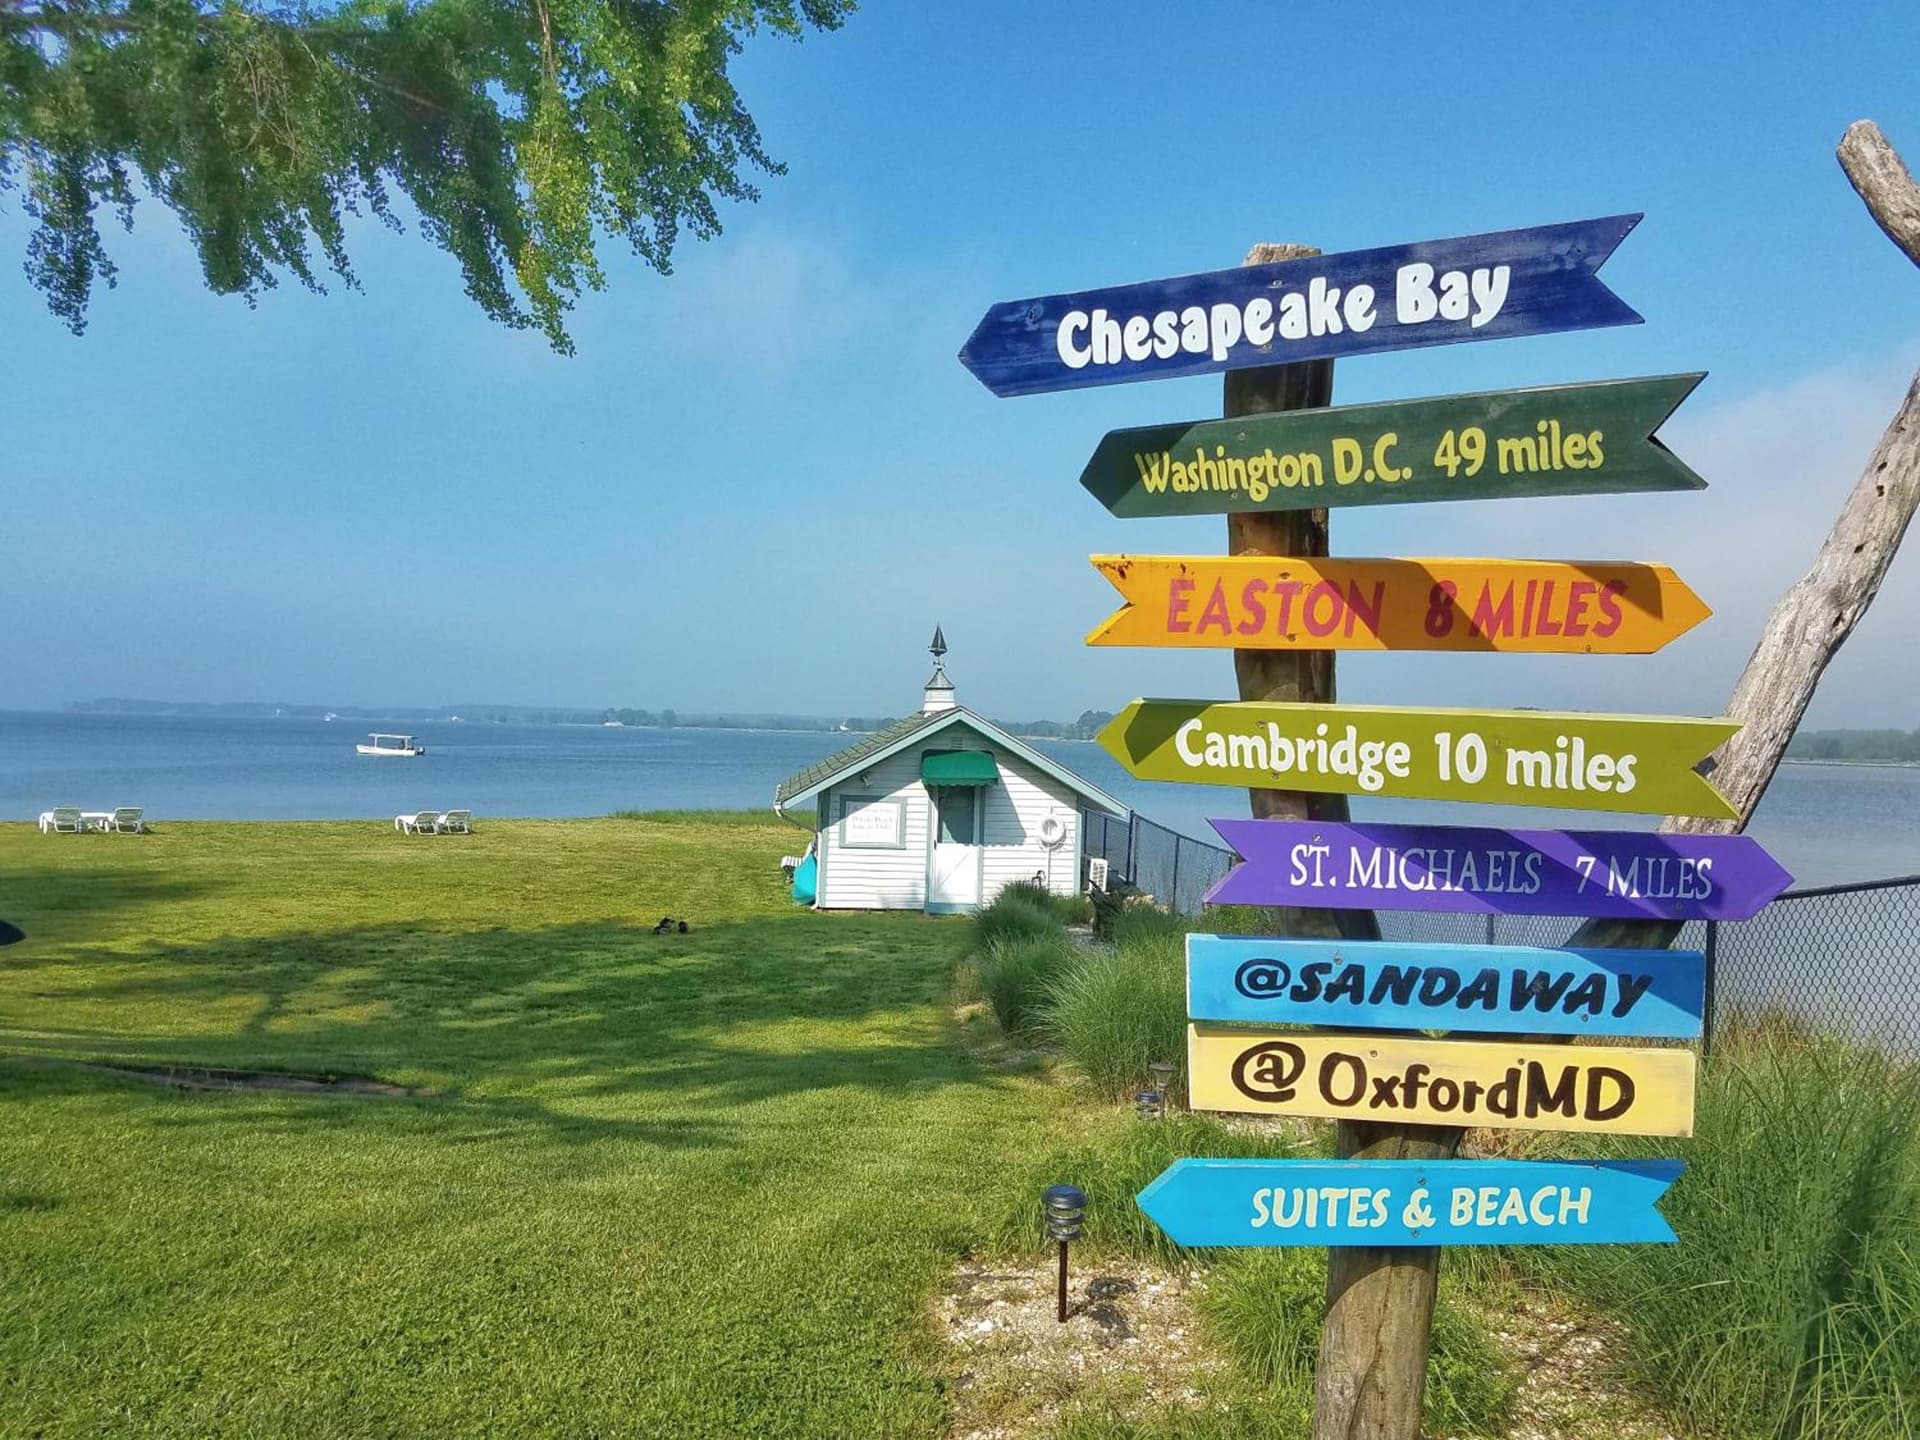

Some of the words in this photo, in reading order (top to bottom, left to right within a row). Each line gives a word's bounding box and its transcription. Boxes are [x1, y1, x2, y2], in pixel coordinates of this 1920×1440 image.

[1056, 276, 1378, 369] Chesapeake
[1395, 262, 1511, 328] Bay
[1134, 445, 1324, 503] Washington
[1331, 432, 1413, 485] D.C.
[1434, 428, 1487, 476] 49
[1495, 419, 1605, 476] miles
[1166, 578, 1385, 640] EASTON
[1424, 581, 1455, 638] 8
[1470, 579, 1626, 639] MILES
[1175, 718, 1411, 793] Cambridge
[1434, 732, 1488, 784] 10
[1505, 734, 1638, 795] miles
[1289, 844, 1338, 888] ST.
[1346, 847, 1543, 896] MICHAELS
[1575, 855, 1596, 894] 7
[1607, 856, 1714, 900] MILES
[1234, 958, 1654, 1018] @SANDAWAY
[1250, 1187, 1389, 1230] SUITES
[1402, 1187, 1436, 1230] &
[1449, 1186, 1592, 1228] BEACH
